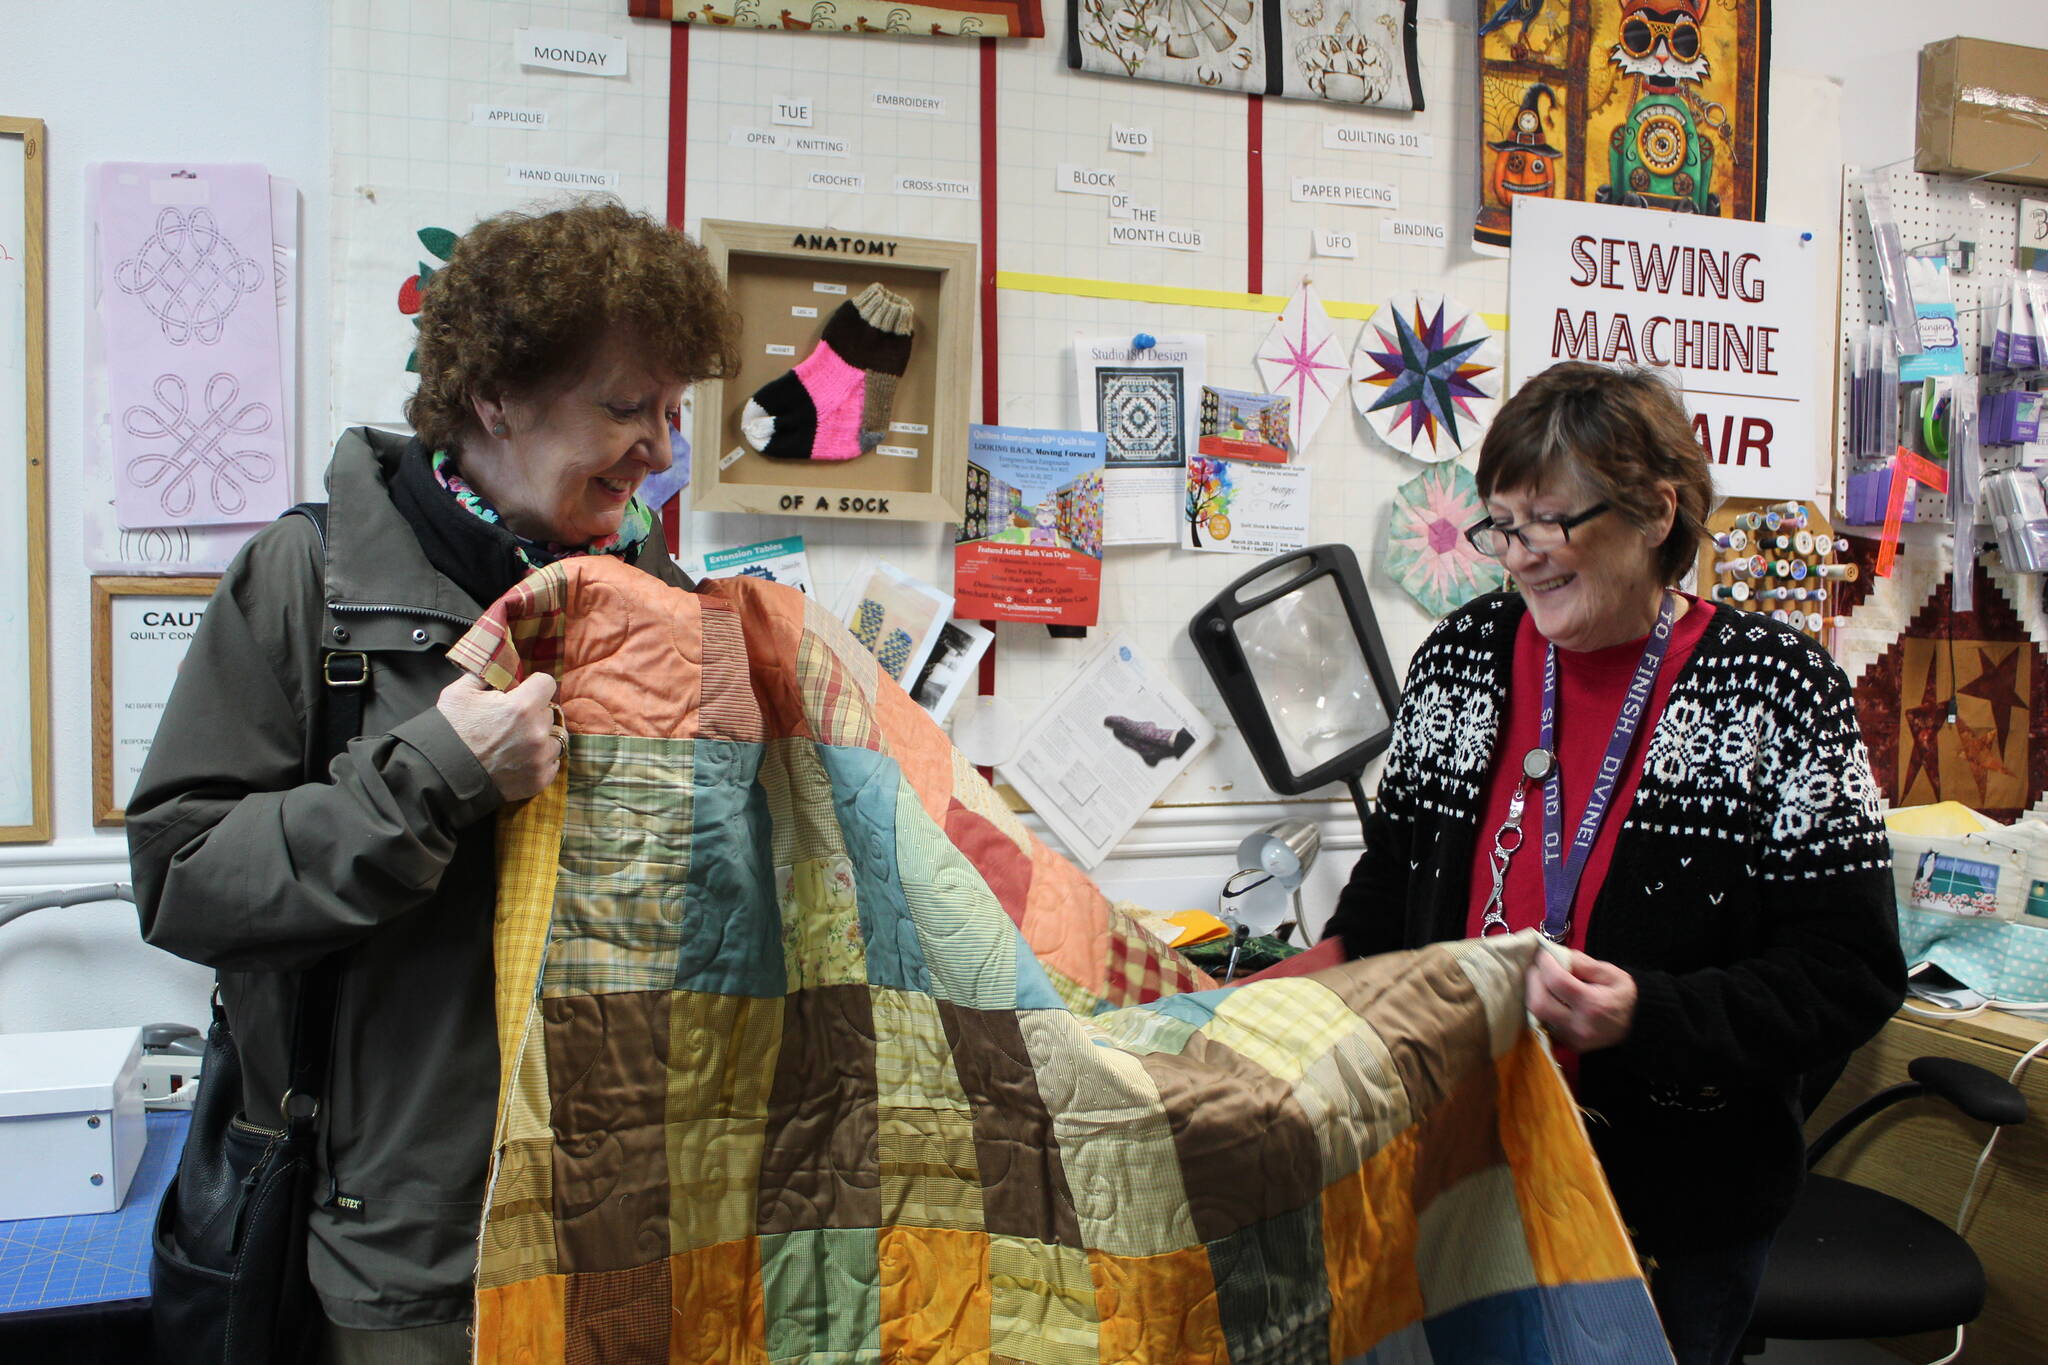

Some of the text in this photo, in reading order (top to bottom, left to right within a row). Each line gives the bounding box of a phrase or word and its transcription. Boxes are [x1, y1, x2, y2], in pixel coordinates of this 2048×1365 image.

[534, 46, 607, 66] MONDAY
[876, 94, 940, 110] EMBROIDERY
[488, 111, 542, 124] APPLIQUE
[778, 104, 808, 120] TUE
[747, 133, 775, 144] OPEN
[796, 139, 844, 152] KNITTING
[1115, 131, 1148, 145] WED
[1337, 129, 1419, 148] QUILTING 101
[519, 169, 606, 185] HAND QUILTING
[812, 174, 858, 187] CROCHET
[1073, 170, 1116, 187] BLOCK
[902, 180, 969, 193] CROSS-STITCH
[1302, 184, 1392, 201] PAPER PIECING
[1112, 195, 1128, 208] OF
[1132, 208, 1157, 222] THE
[1113, 227, 1201, 245] MONTH CLUB
[1393, 223, 1444, 238] BINDING
[793, 233, 897, 257] ANATOMY
[1326, 236, 1352, 249] UFO
[1570, 235, 1765, 303] SEWING
[1551, 308, 1779, 376] MACHINE
[1091, 347, 1125, 360] Studio
[1148, 348, 1188, 362] Design
[1691, 413, 1774, 467] AIR
[974, 443, 1008, 453] LOOKING
[1035, 447, 1062, 457] Moving
[1064, 450, 1096, 459] Forward
[780, 494, 889, 514] OF A SOCK
[709, 550, 753, 564] Extension
[753, 543, 784, 555] Tables
[977, 545, 1071, 559] Featured Artist: Ruth Van Dyke
[130, 631, 194, 640] QUILT CON
[1544, 642, 1554, 692] HUM
[1541, 707, 1553, 732] IS
[1574, 611, 1672, 848] TO FINISH, DIVINE!
[1545, 832, 1559, 864] TO
